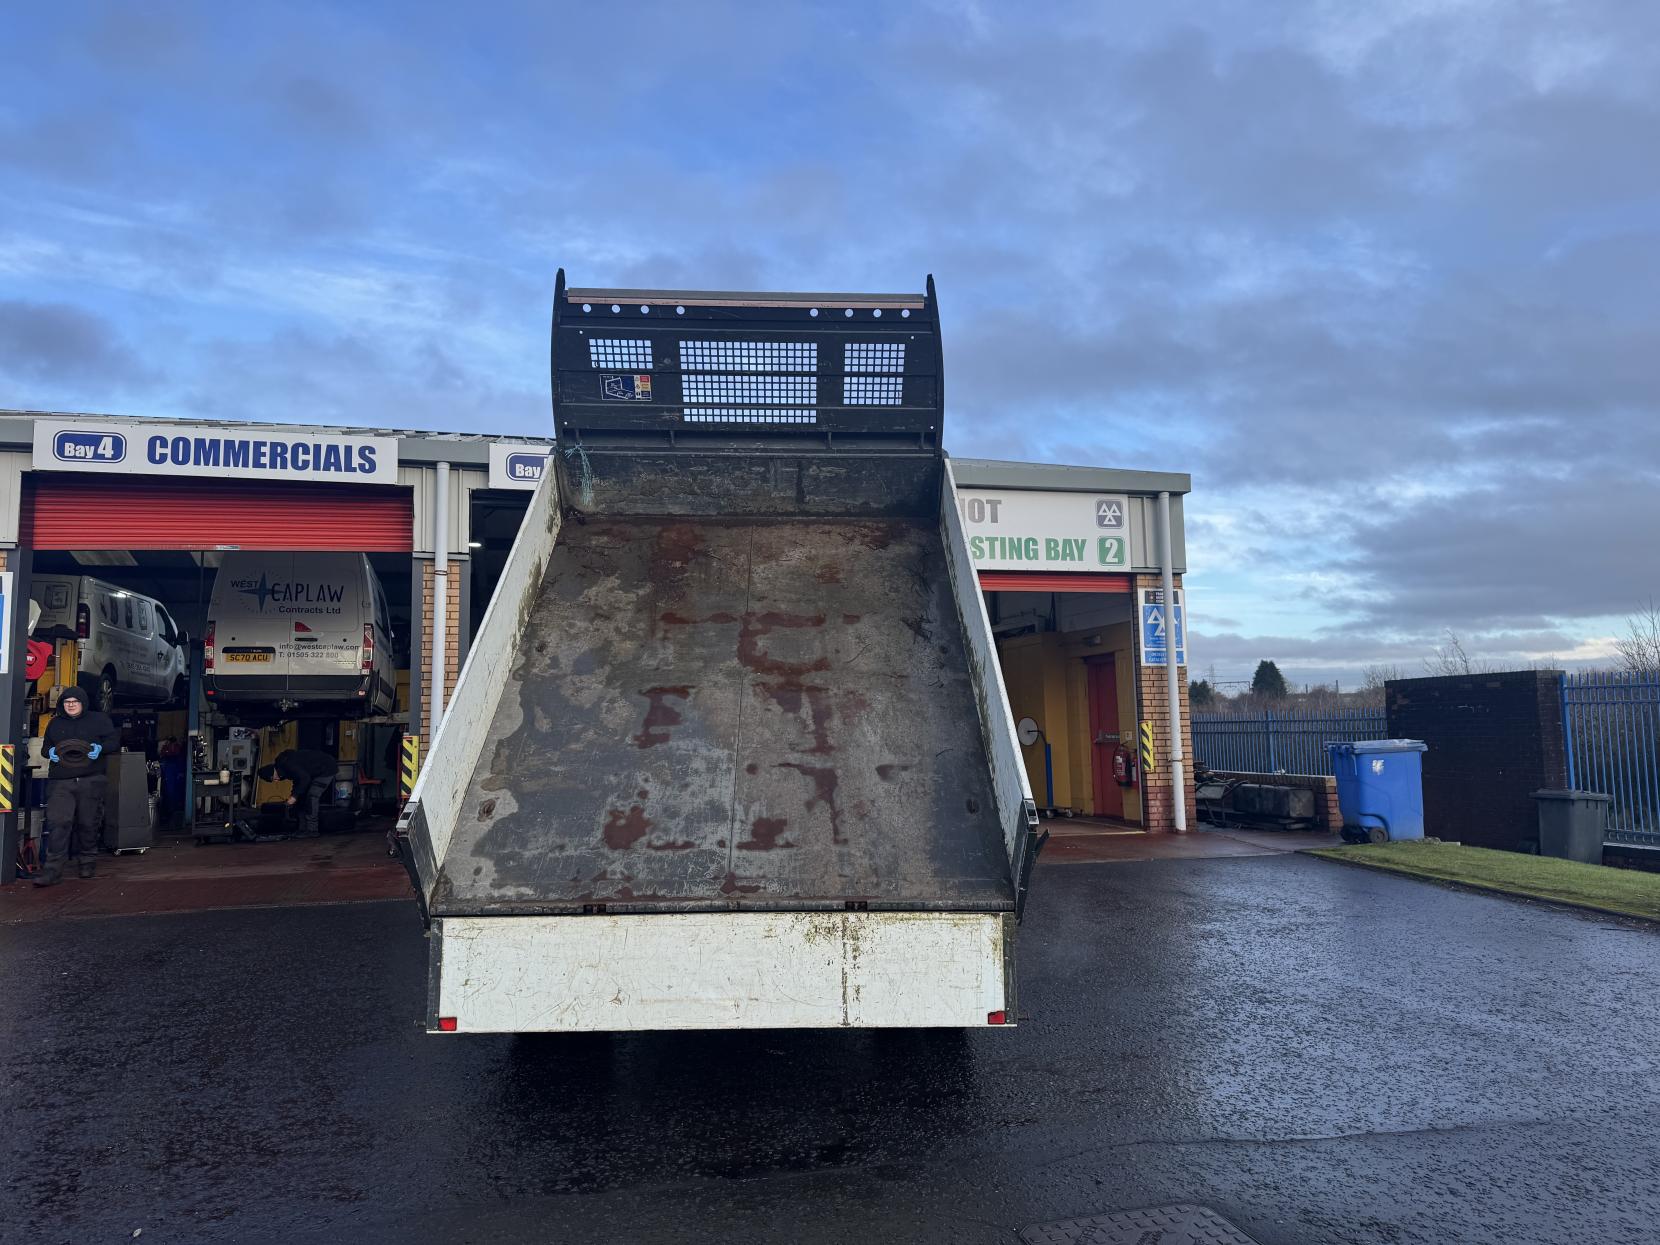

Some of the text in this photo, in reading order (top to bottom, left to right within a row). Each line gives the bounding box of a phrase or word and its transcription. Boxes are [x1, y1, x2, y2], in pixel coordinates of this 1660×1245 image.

[64, 435, 376, 474] Bay 4 COMMERCIALS
[515, 463, 541, 479] Bay
[1045, 538, 1088, 562] BAY
[1104, 538, 1119, 563] 2
[230, 580, 259, 588] WEST
[271, 583, 344, 602] CAPLAW
[278, 605, 341, 614] Contracts Ltd
[279, 643, 361, 651] info@westcaplaw.com
